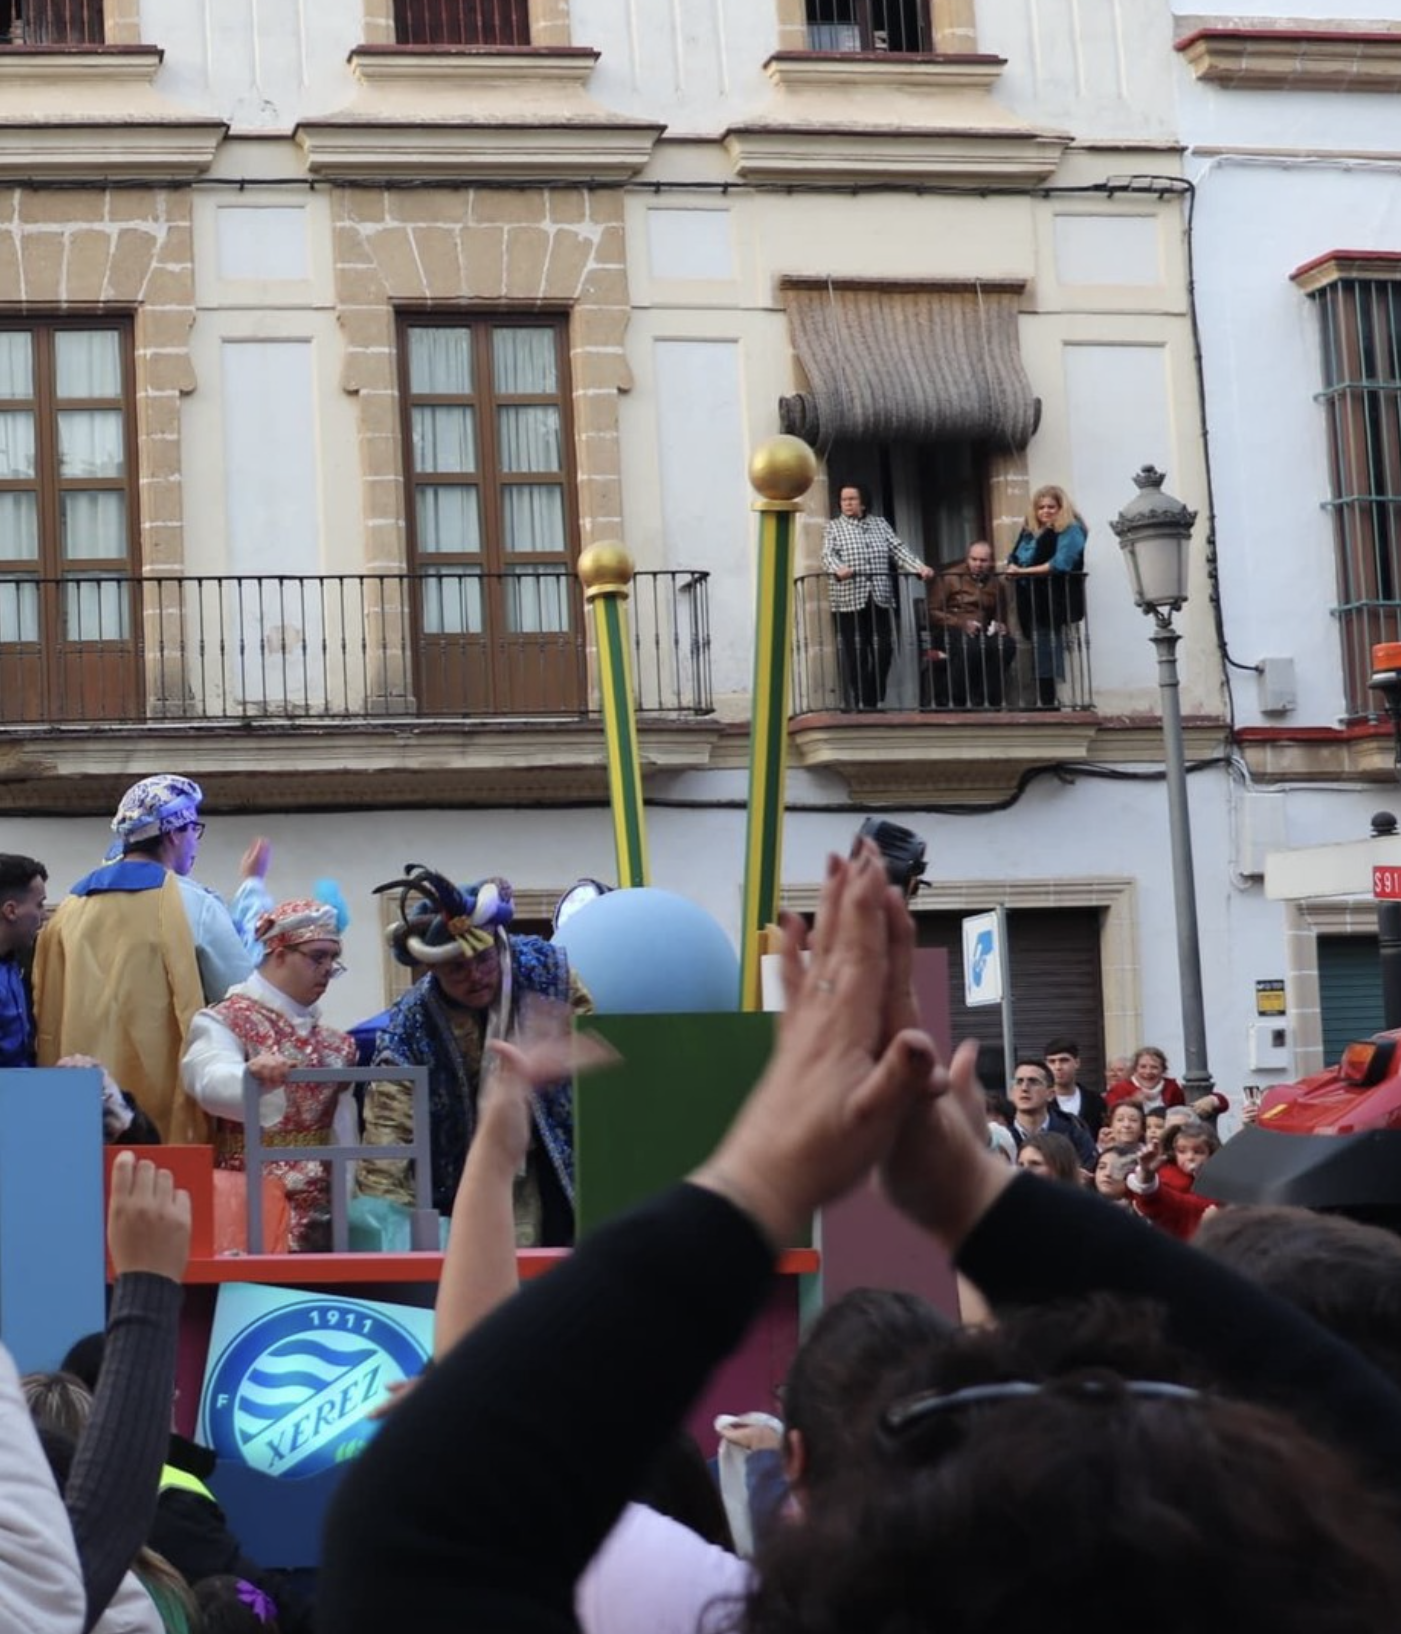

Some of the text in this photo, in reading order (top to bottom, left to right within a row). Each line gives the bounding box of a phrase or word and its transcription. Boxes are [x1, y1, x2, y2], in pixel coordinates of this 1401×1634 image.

[309, 1310, 373, 1334] 1911
[216, 1393, 229, 1409] F
[266, 1364, 381, 1470] XEREZ
